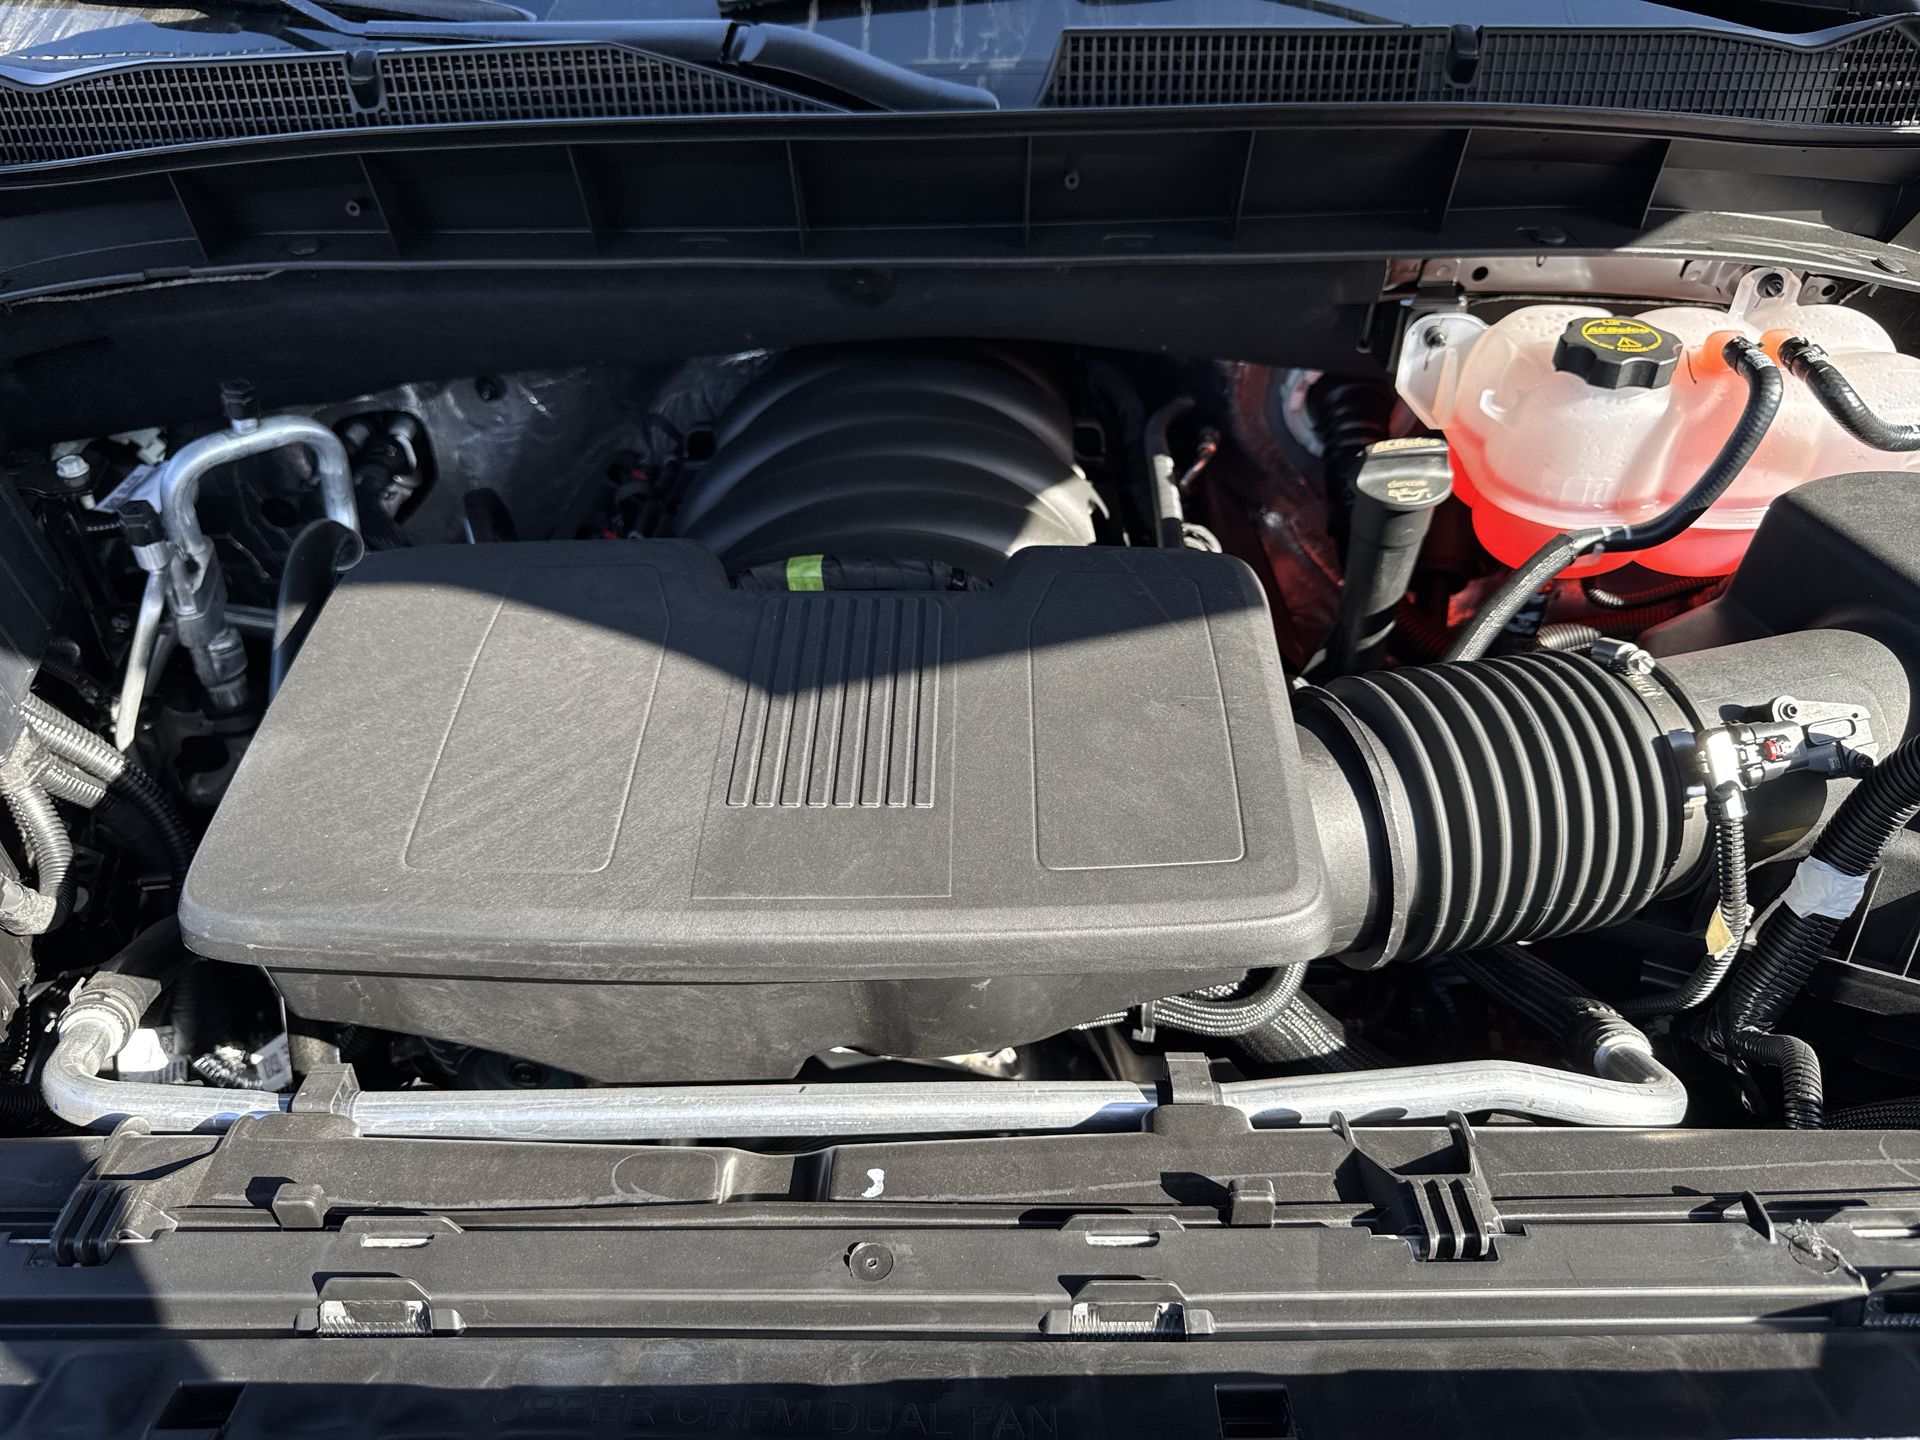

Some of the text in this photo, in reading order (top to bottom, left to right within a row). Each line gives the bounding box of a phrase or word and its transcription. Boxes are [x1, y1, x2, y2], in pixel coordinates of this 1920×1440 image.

[490, 1393, 1059, 1440] UPPER CRFM DUAL FAN
